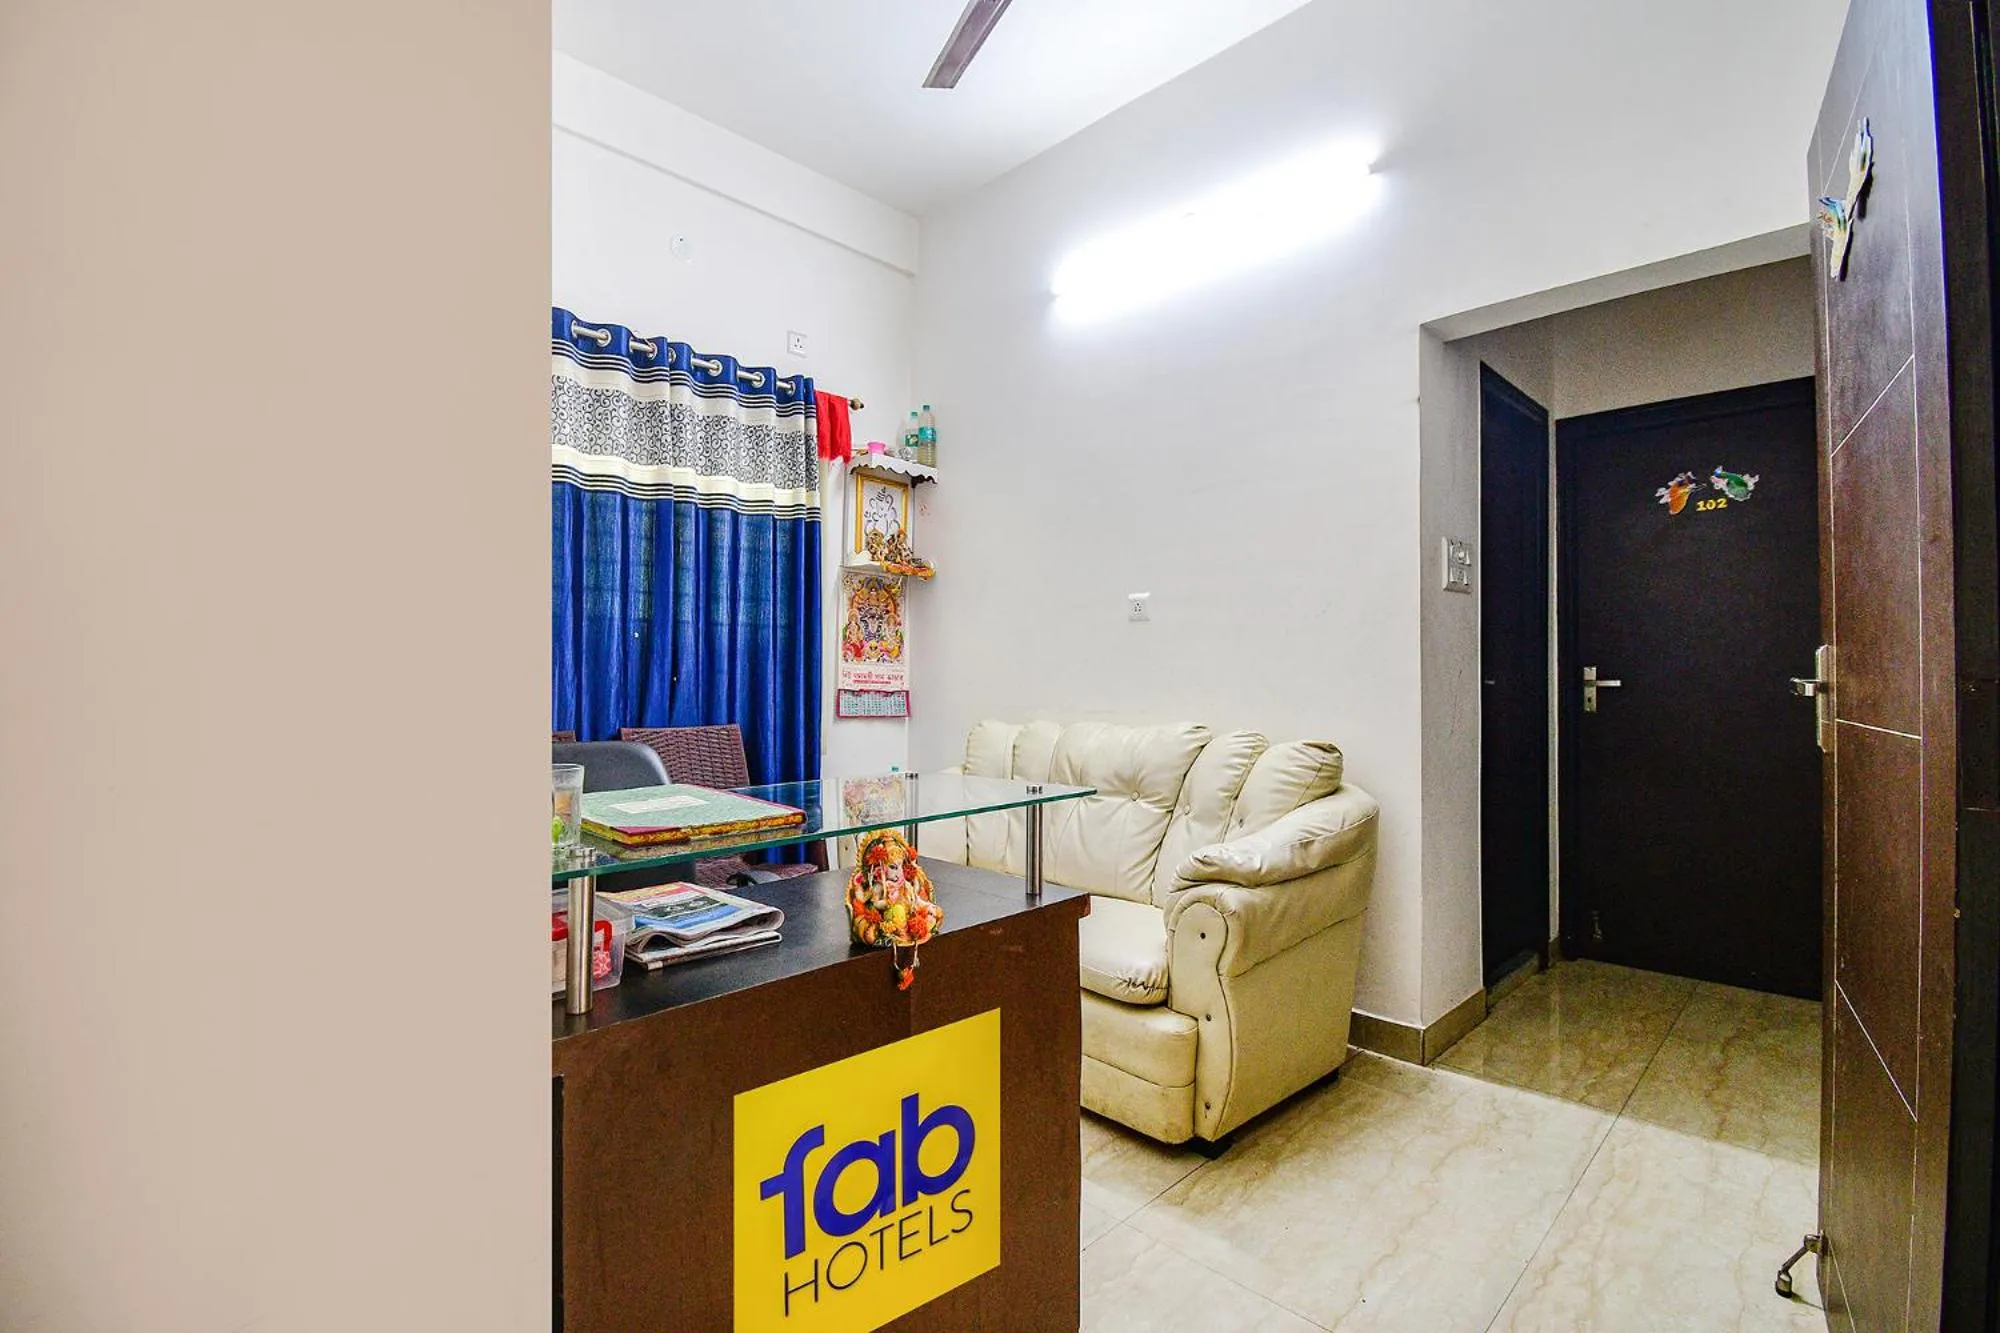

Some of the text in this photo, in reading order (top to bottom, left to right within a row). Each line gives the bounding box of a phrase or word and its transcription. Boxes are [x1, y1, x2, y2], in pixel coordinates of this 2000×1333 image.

[1696, 498, 1728, 512] 102
[760, 1092, 976, 1260] fab
[784, 1189, 973, 1317] HOTELS
